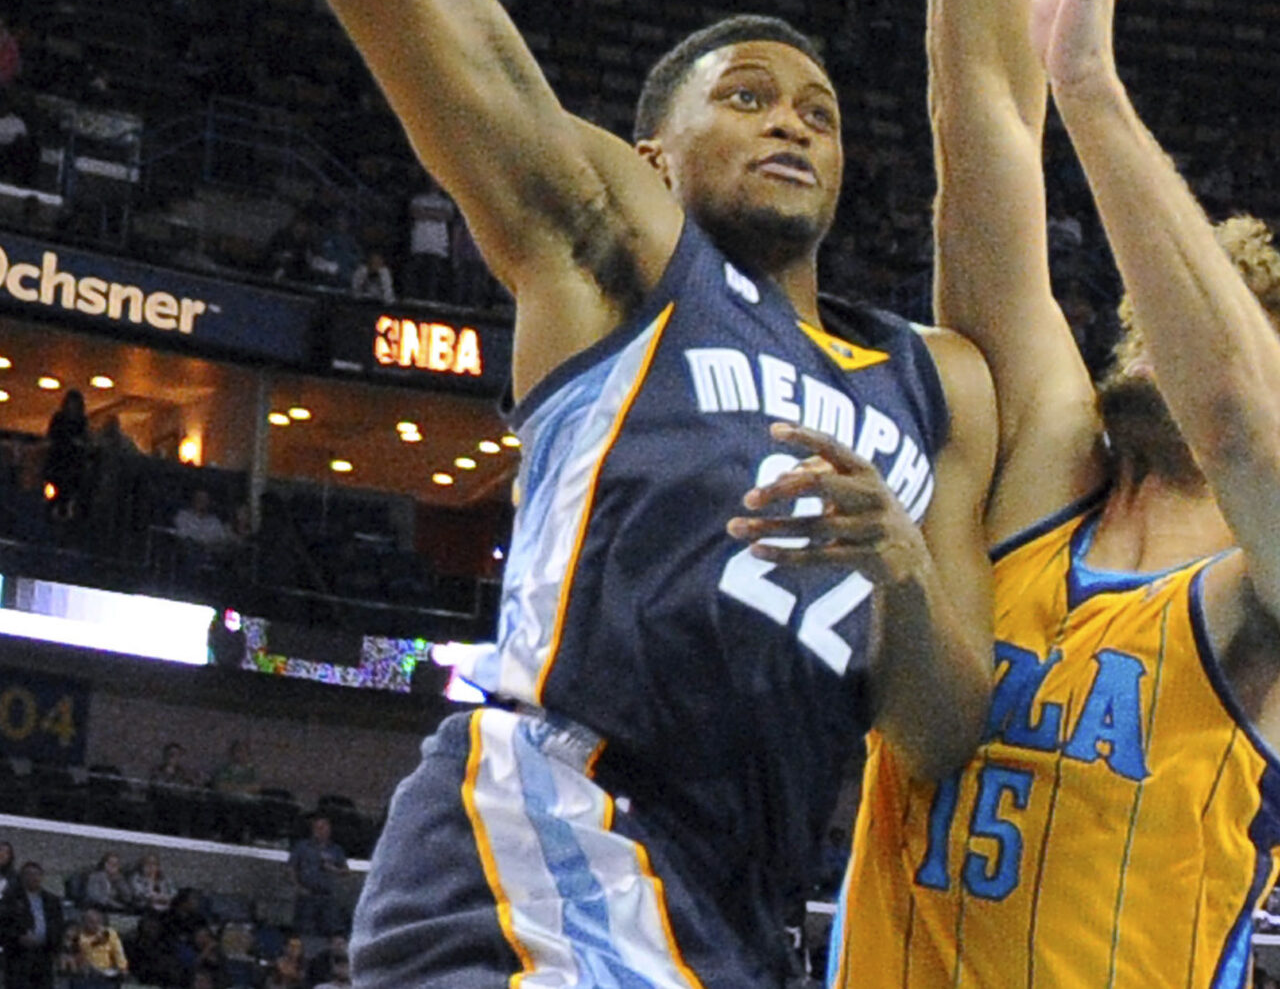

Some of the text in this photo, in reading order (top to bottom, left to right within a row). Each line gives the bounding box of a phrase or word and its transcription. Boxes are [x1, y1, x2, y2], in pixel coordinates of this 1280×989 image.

[0, 246, 206, 334] chsner
[398, 318, 482, 376] NBA
[914, 765, 1034, 902] 15
